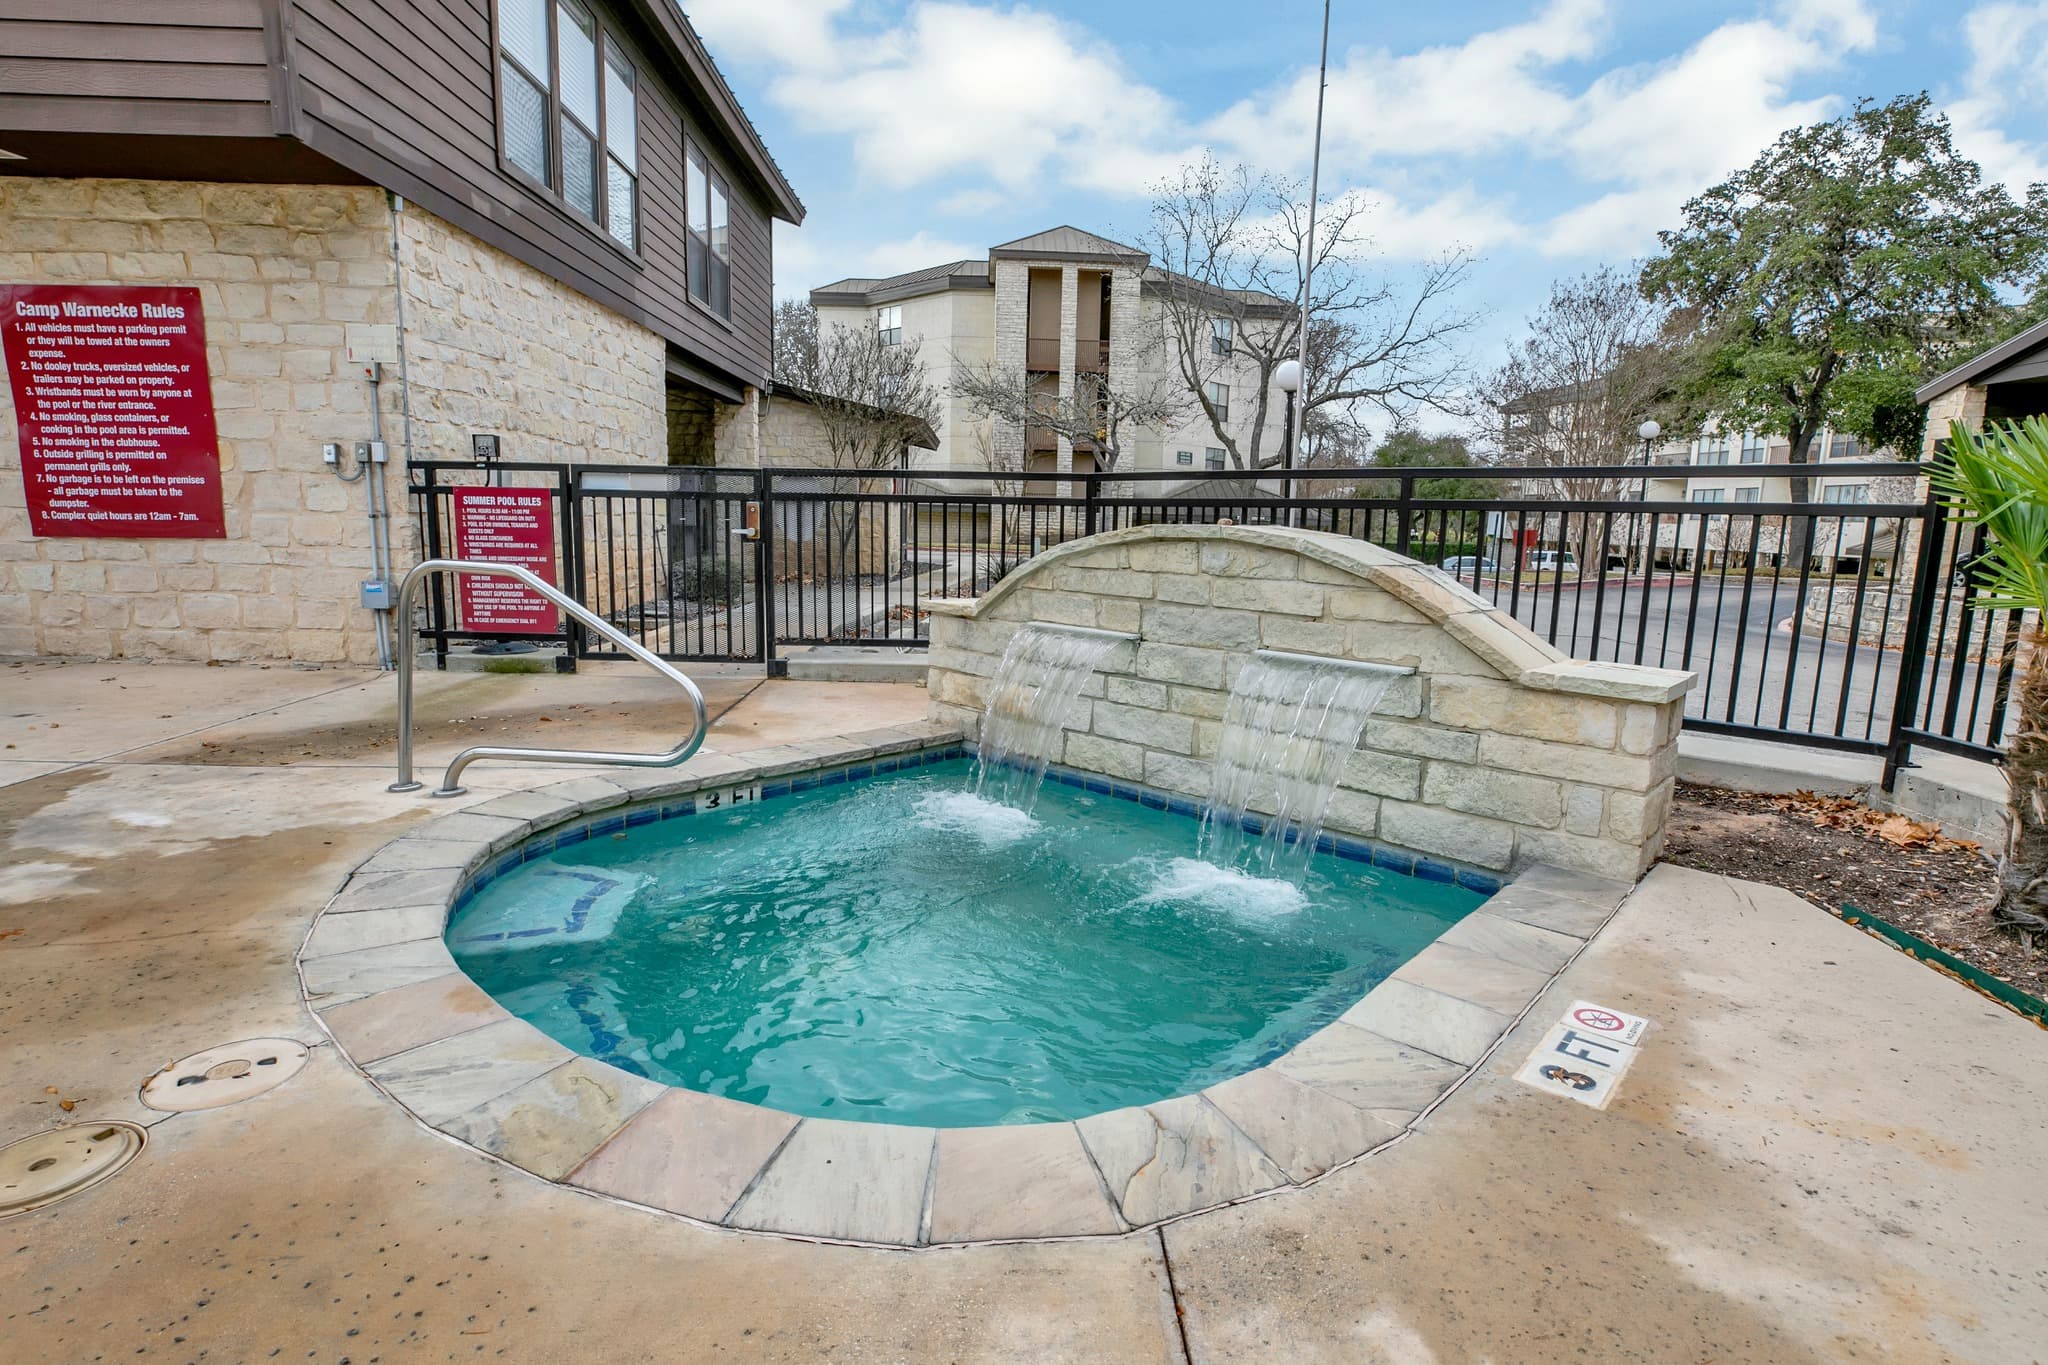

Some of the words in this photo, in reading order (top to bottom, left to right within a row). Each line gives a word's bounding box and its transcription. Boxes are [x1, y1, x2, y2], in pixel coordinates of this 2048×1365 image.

[16, 301, 60, 319] Camp
[62, 303, 138, 318] Warnecke
[142, 304, 184, 319] Rules
[15, 323, 23, 331] 1.
[25, 323, 35, 332] All
[38, 324, 72, 332] vehicles
[74, 325, 95, 333] must
[97, 325, 117, 333] have
[126, 325, 157, 335] parking
[159, 325, 186, 336] permit
[37, 336, 55, 347] they
[57, 336, 73, 345] will
[75, 337, 85, 345] be
[87, 337, 112, 346] towed
[114, 338, 123, 346] at
[125, 337, 138, 346] the
[140, 339, 170, 347] owners
[33, 375, 63, 383] trailers
[65, 377, 81, 386] may
[84, 375, 94, 384] be
[96, 375, 124, 386] parked
[127, 377, 137, 385] on
[139, 377, 174, 386] property.
[26, 387, 34, 396] 3.
[35, 387, 81, 396] Wristbands
[84, 388, 104, 397] must
[106, 388, 116, 397] be
[140, 388, 150, 399] by
[152, 391, 181, 400] anyone
[183, 390, 192, 398] at
[38, 400, 51, 409] the
[53, 400, 70, 411] pool
[83, 401, 96, 409] the
[98, 401, 116, 409] river
[118, 401, 156, 410] entrance.
[30, 413, 38, 421] 4.
[40, 413, 50, 421] No
[52, 413, 89, 424] smoking,
[91, 413, 112, 424] glass
[114, 414, 159, 424] containers,
[41, 426, 72, 436] cooking
[75, 426, 83, 434] in
[85, 426, 97, 434] the
[100, 426, 117, 436] pool
[139, 426, 146, 435] is
[148, 427, 190, 437] permitted.
[33, 438, 40, 446] 5.
[42, 438, 53, 446] No
[55, 438, 89, 448] smoking
[91, 438, 99, 447] in
[102, 438, 114, 447] the
[117, 438, 160, 447] clubhouse.
[34, 450, 42, 458] 6.
[44, 450, 74, 459] Outside
[76, 450, 104, 461] grilling
[106, 450, 113, 459] is
[115, 451, 154, 461] permitted
[45, 463, 88, 473] permanent
[90, 463, 111, 473] grills
[113, 463, 131, 473] only.
[36, 475, 44, 483] 7.
[46, 475, 57, 483] No
[59, 475, 92, 485] garbage
[94, 475, 102, 483] is
[104, 476, 111, 484] to
[113, 475, 123, 484] be
[125, 475, 139, 484] left
[153, 475, 166, 484] the
[168, 476, 205, 486] premises
[54, 487, 64, 495] all
[66, 487, 99, 498] garbage
[101, 488, 121, 496] must
[123, 487, 133, 496] be
[135, 488, 158, 496] taken
[160, 488, 168, 496] to
[170, 488, 182, 497] the
[50, 500, 89, 510] dumpster.
[463, 496, 495, 505] SUMMER
[497, 497, 517, 506] POOL
[518, 497, 542, 506] RULES
[42, 511, 49, 519] 8.
[51, 511, 86, 521] Complex
[88, 512, 108, 522] quiet
[110, 512, 132, 520] hours
[150, 512, 171, 521] 12am
[179, 513, 199, 521] 7am.
[705, 791, 720, 809] 3
[1555, 1030, 1619, 1067] FT
[1539, 1064, 1597, 1091] 3
